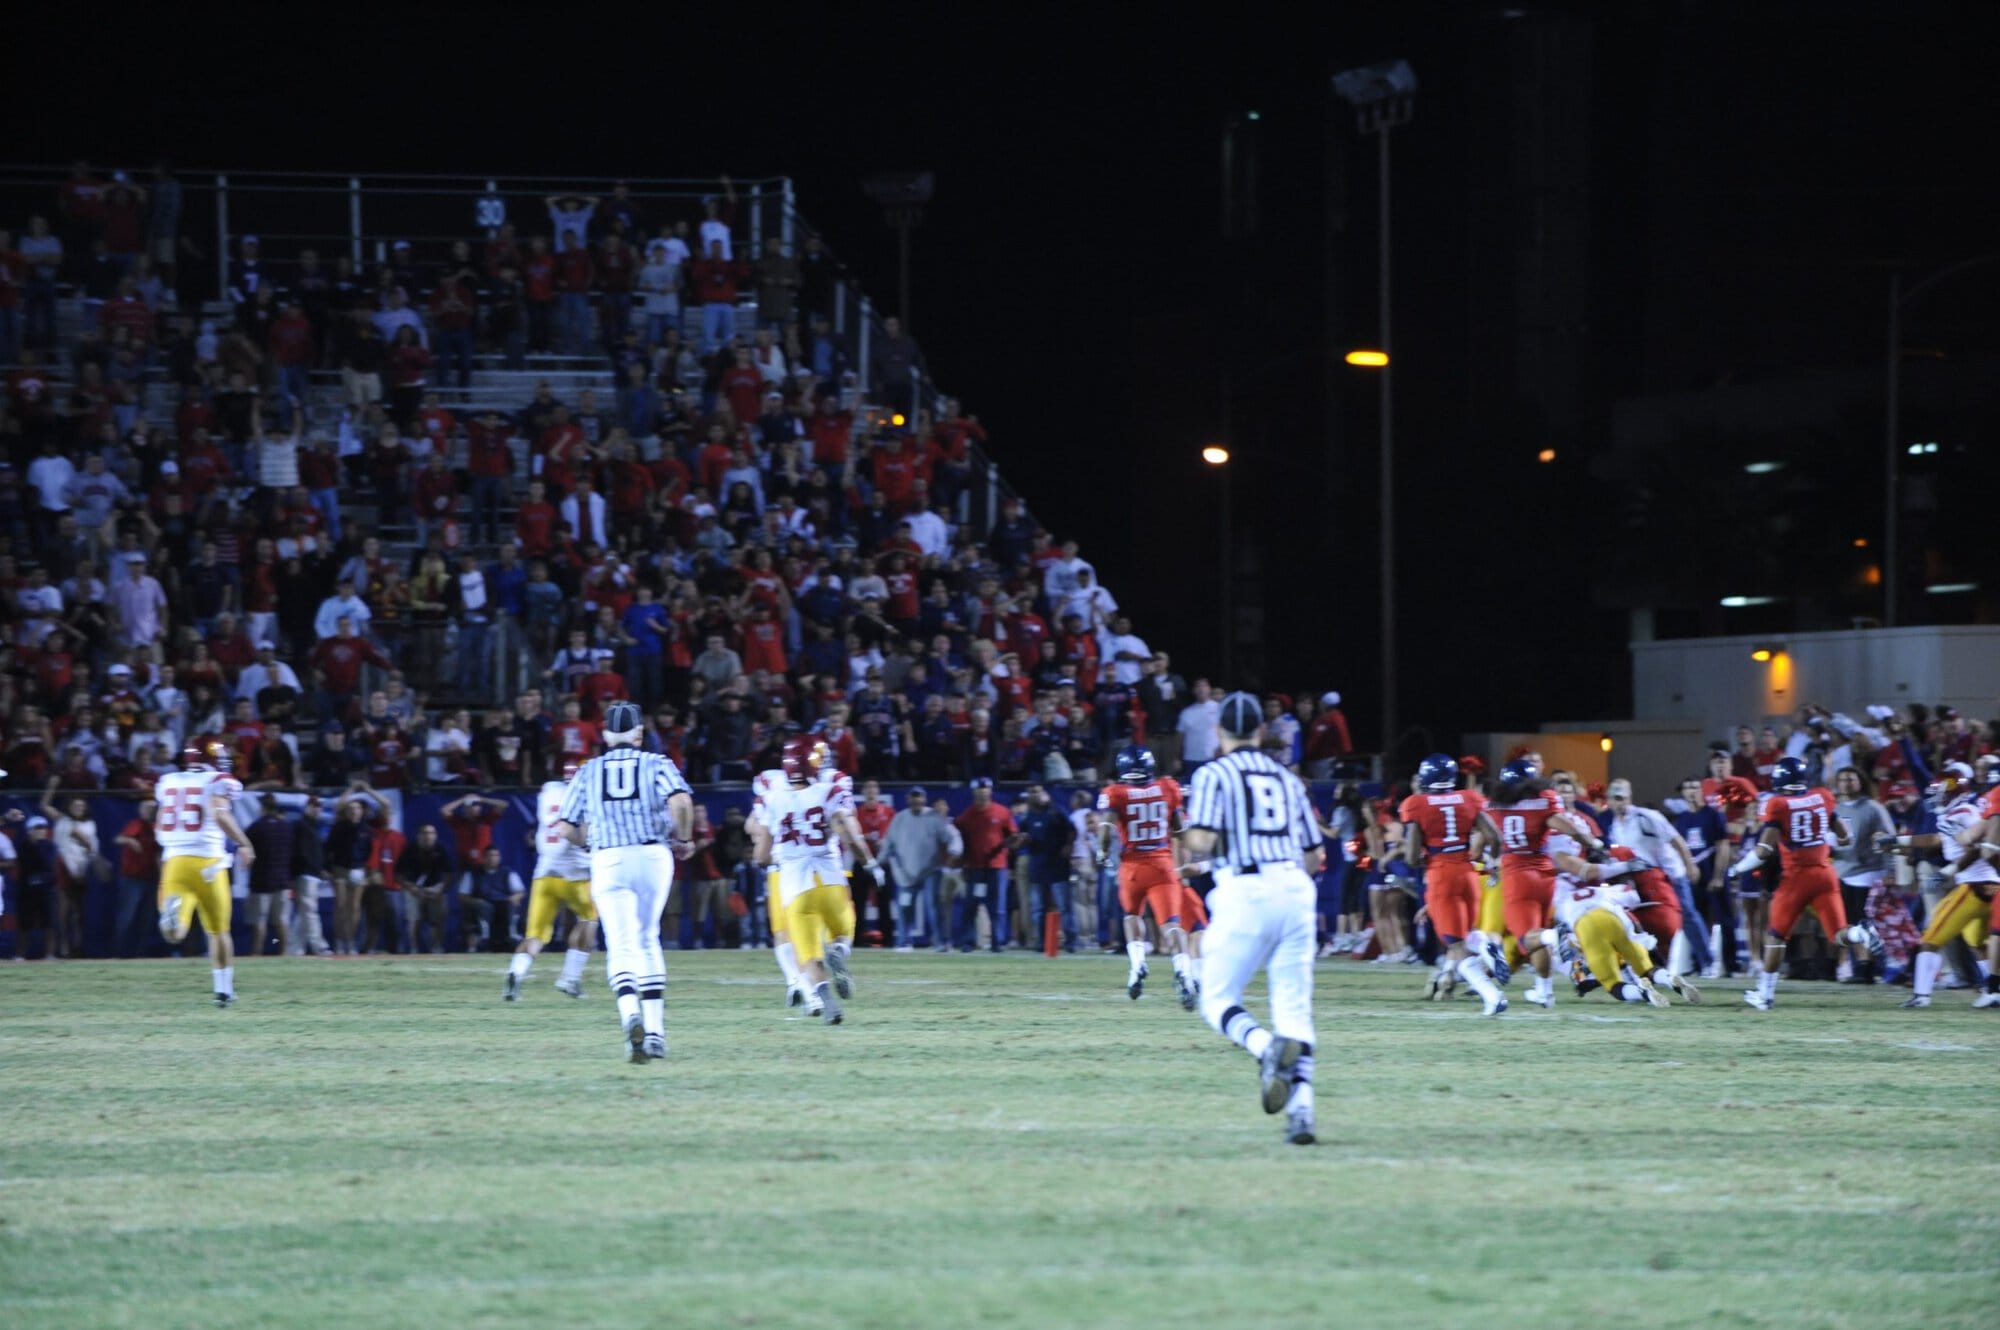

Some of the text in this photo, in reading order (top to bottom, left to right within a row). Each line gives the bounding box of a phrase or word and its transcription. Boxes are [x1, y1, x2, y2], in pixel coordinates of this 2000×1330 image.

[477, 199, 505, 225] 30
[605, 759, 639, 797] U
[1127, 801, 1168, 843] 29
[1250, 776, 1287, 831] B
[780, 805, 827, 847] 43
[1439, 806, 1460, 843] 1
[1502, 815, 1529, 849] 8
[1790, 806, 1830, 843] 81
